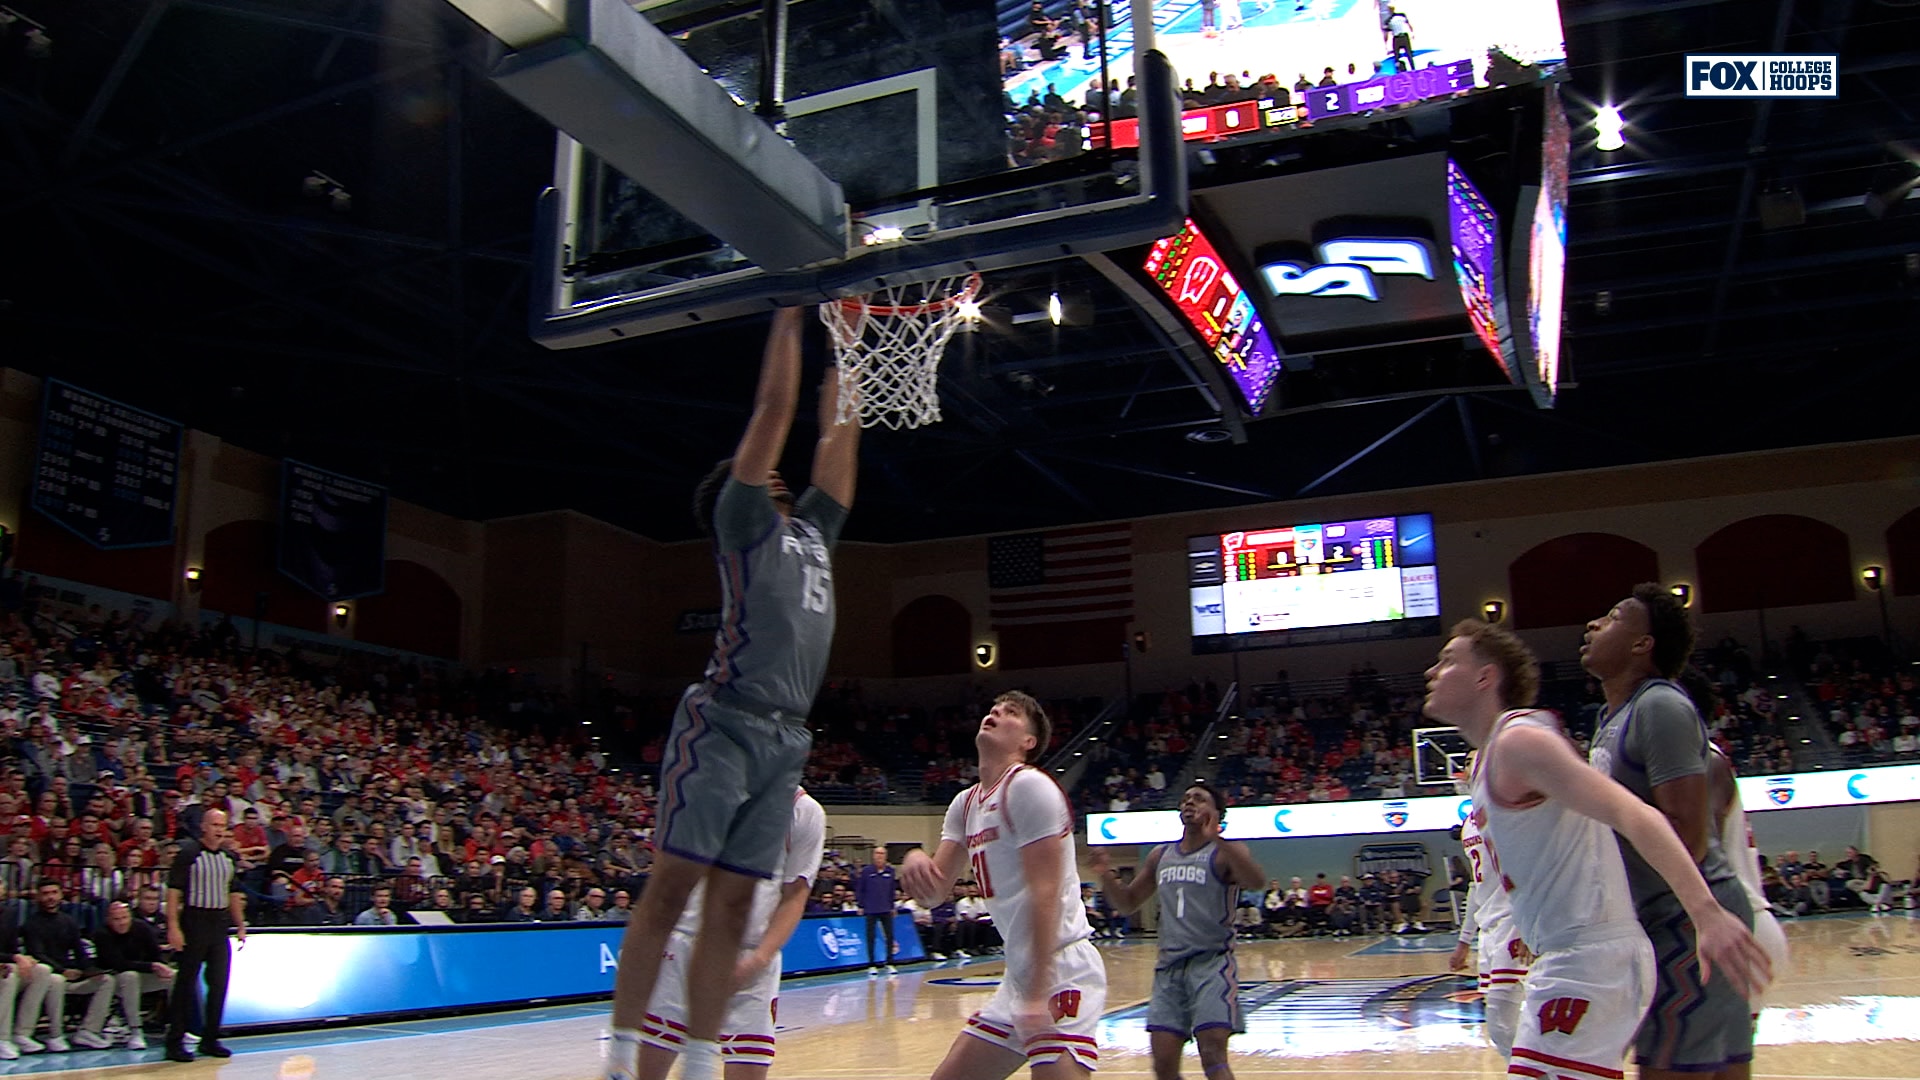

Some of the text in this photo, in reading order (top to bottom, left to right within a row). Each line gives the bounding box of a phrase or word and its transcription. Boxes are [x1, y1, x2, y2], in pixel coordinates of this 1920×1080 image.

[1325, 92, 1340, 112] 2
[801, 563, 832, 615] 15
[1159, 865, 1206, 885] FROGS
[1176, 887, 1185, 918] 1
[1048, 989, 1081, 1024] W
[1537, 996, 1591, 1035] W
